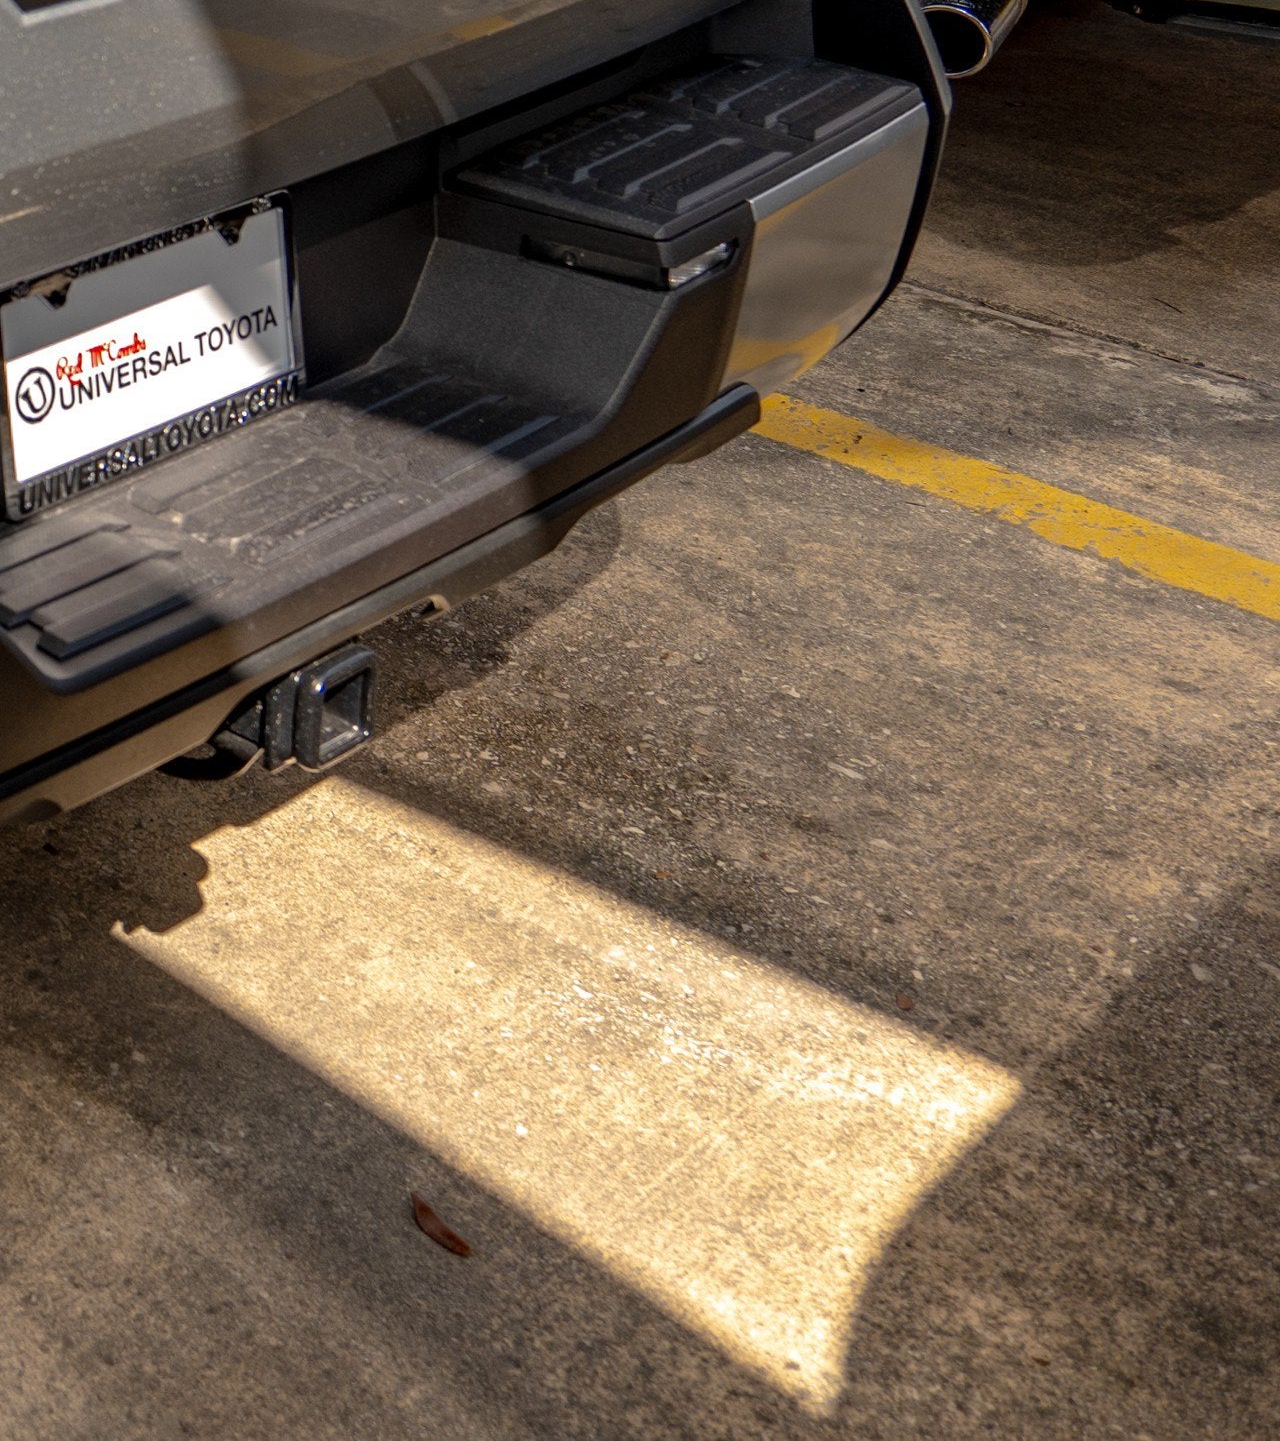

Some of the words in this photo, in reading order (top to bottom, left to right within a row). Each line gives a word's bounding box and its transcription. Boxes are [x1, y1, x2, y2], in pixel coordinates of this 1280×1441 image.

[59, 341, 192, 410] UNIVERSAL
[194, 304, 279, 357] TOYOTA
[17, 373, 300, 515] UNIVERSALTOYOTA.COM
